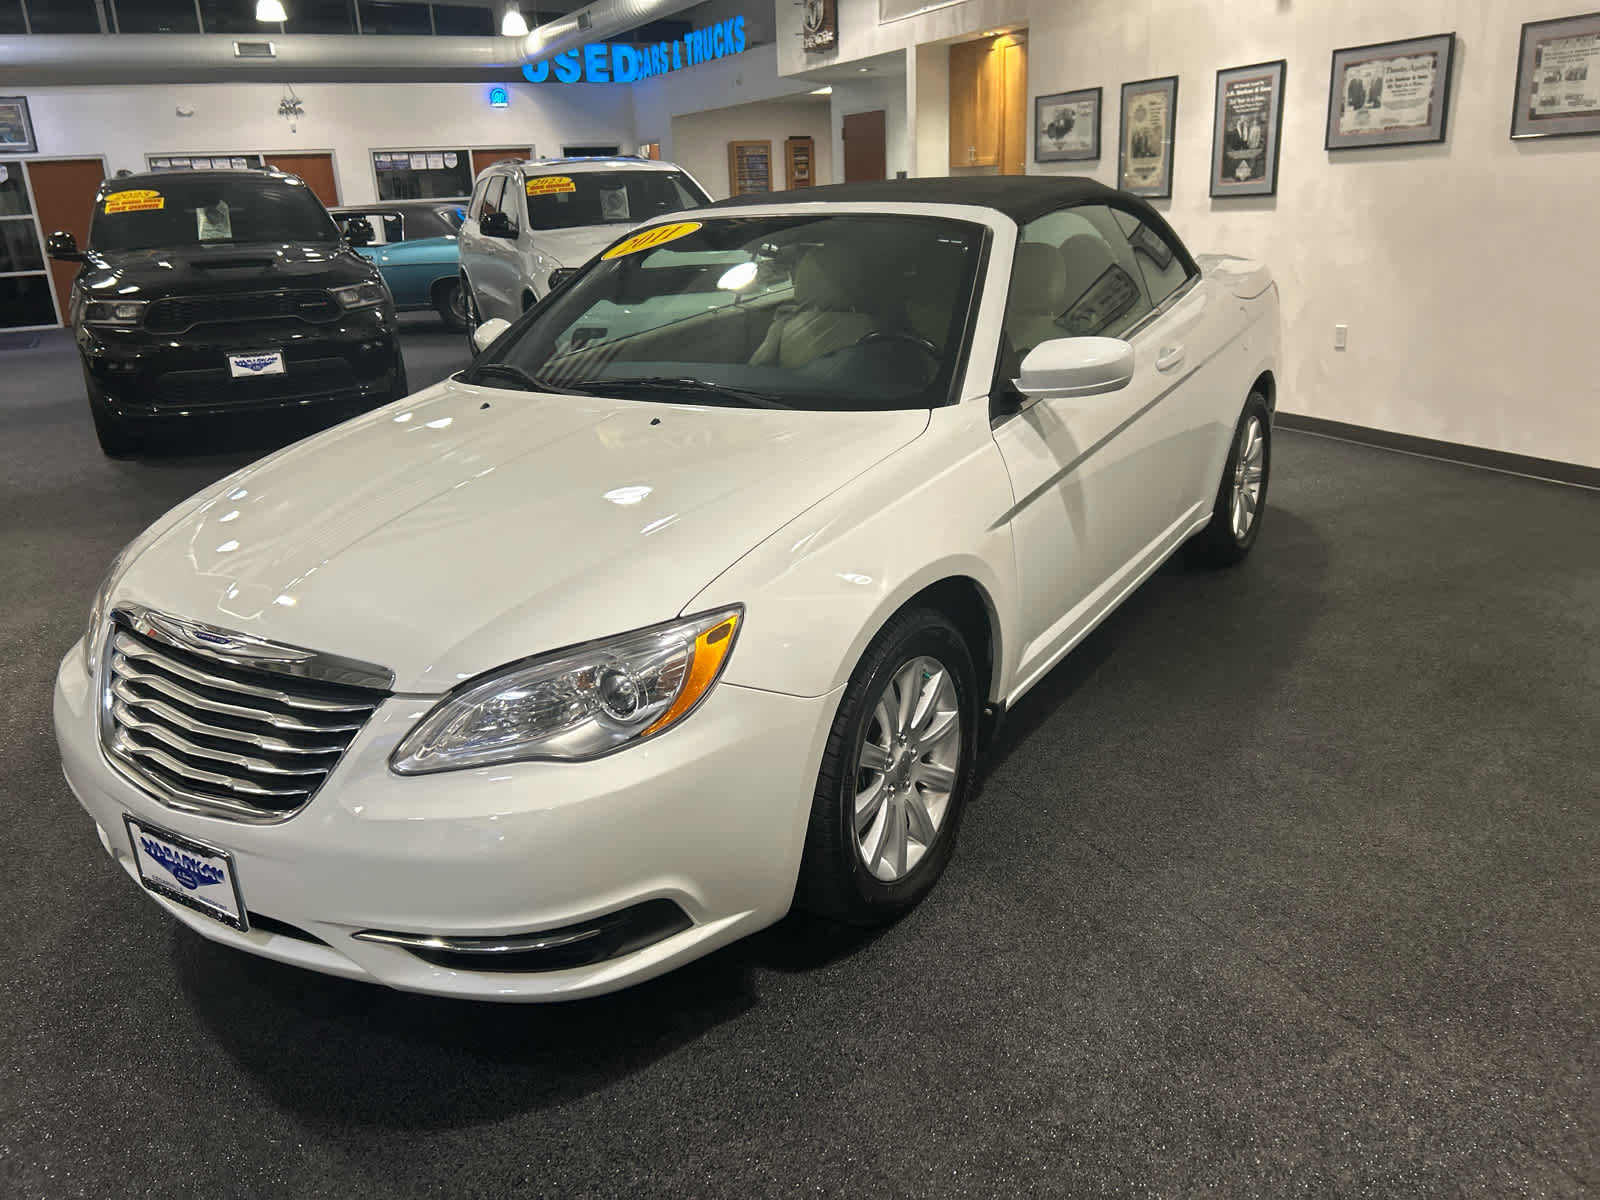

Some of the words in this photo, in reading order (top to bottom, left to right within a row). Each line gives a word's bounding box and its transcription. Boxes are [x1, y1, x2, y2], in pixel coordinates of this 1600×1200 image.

[522, 43, 636, 83] USED
[635, 41, 669, 80] CARS
[672, 40, 682, 70] &
[684, 15, 746, 66] TRUCKS
[616, 225, 683, 255] 2011
